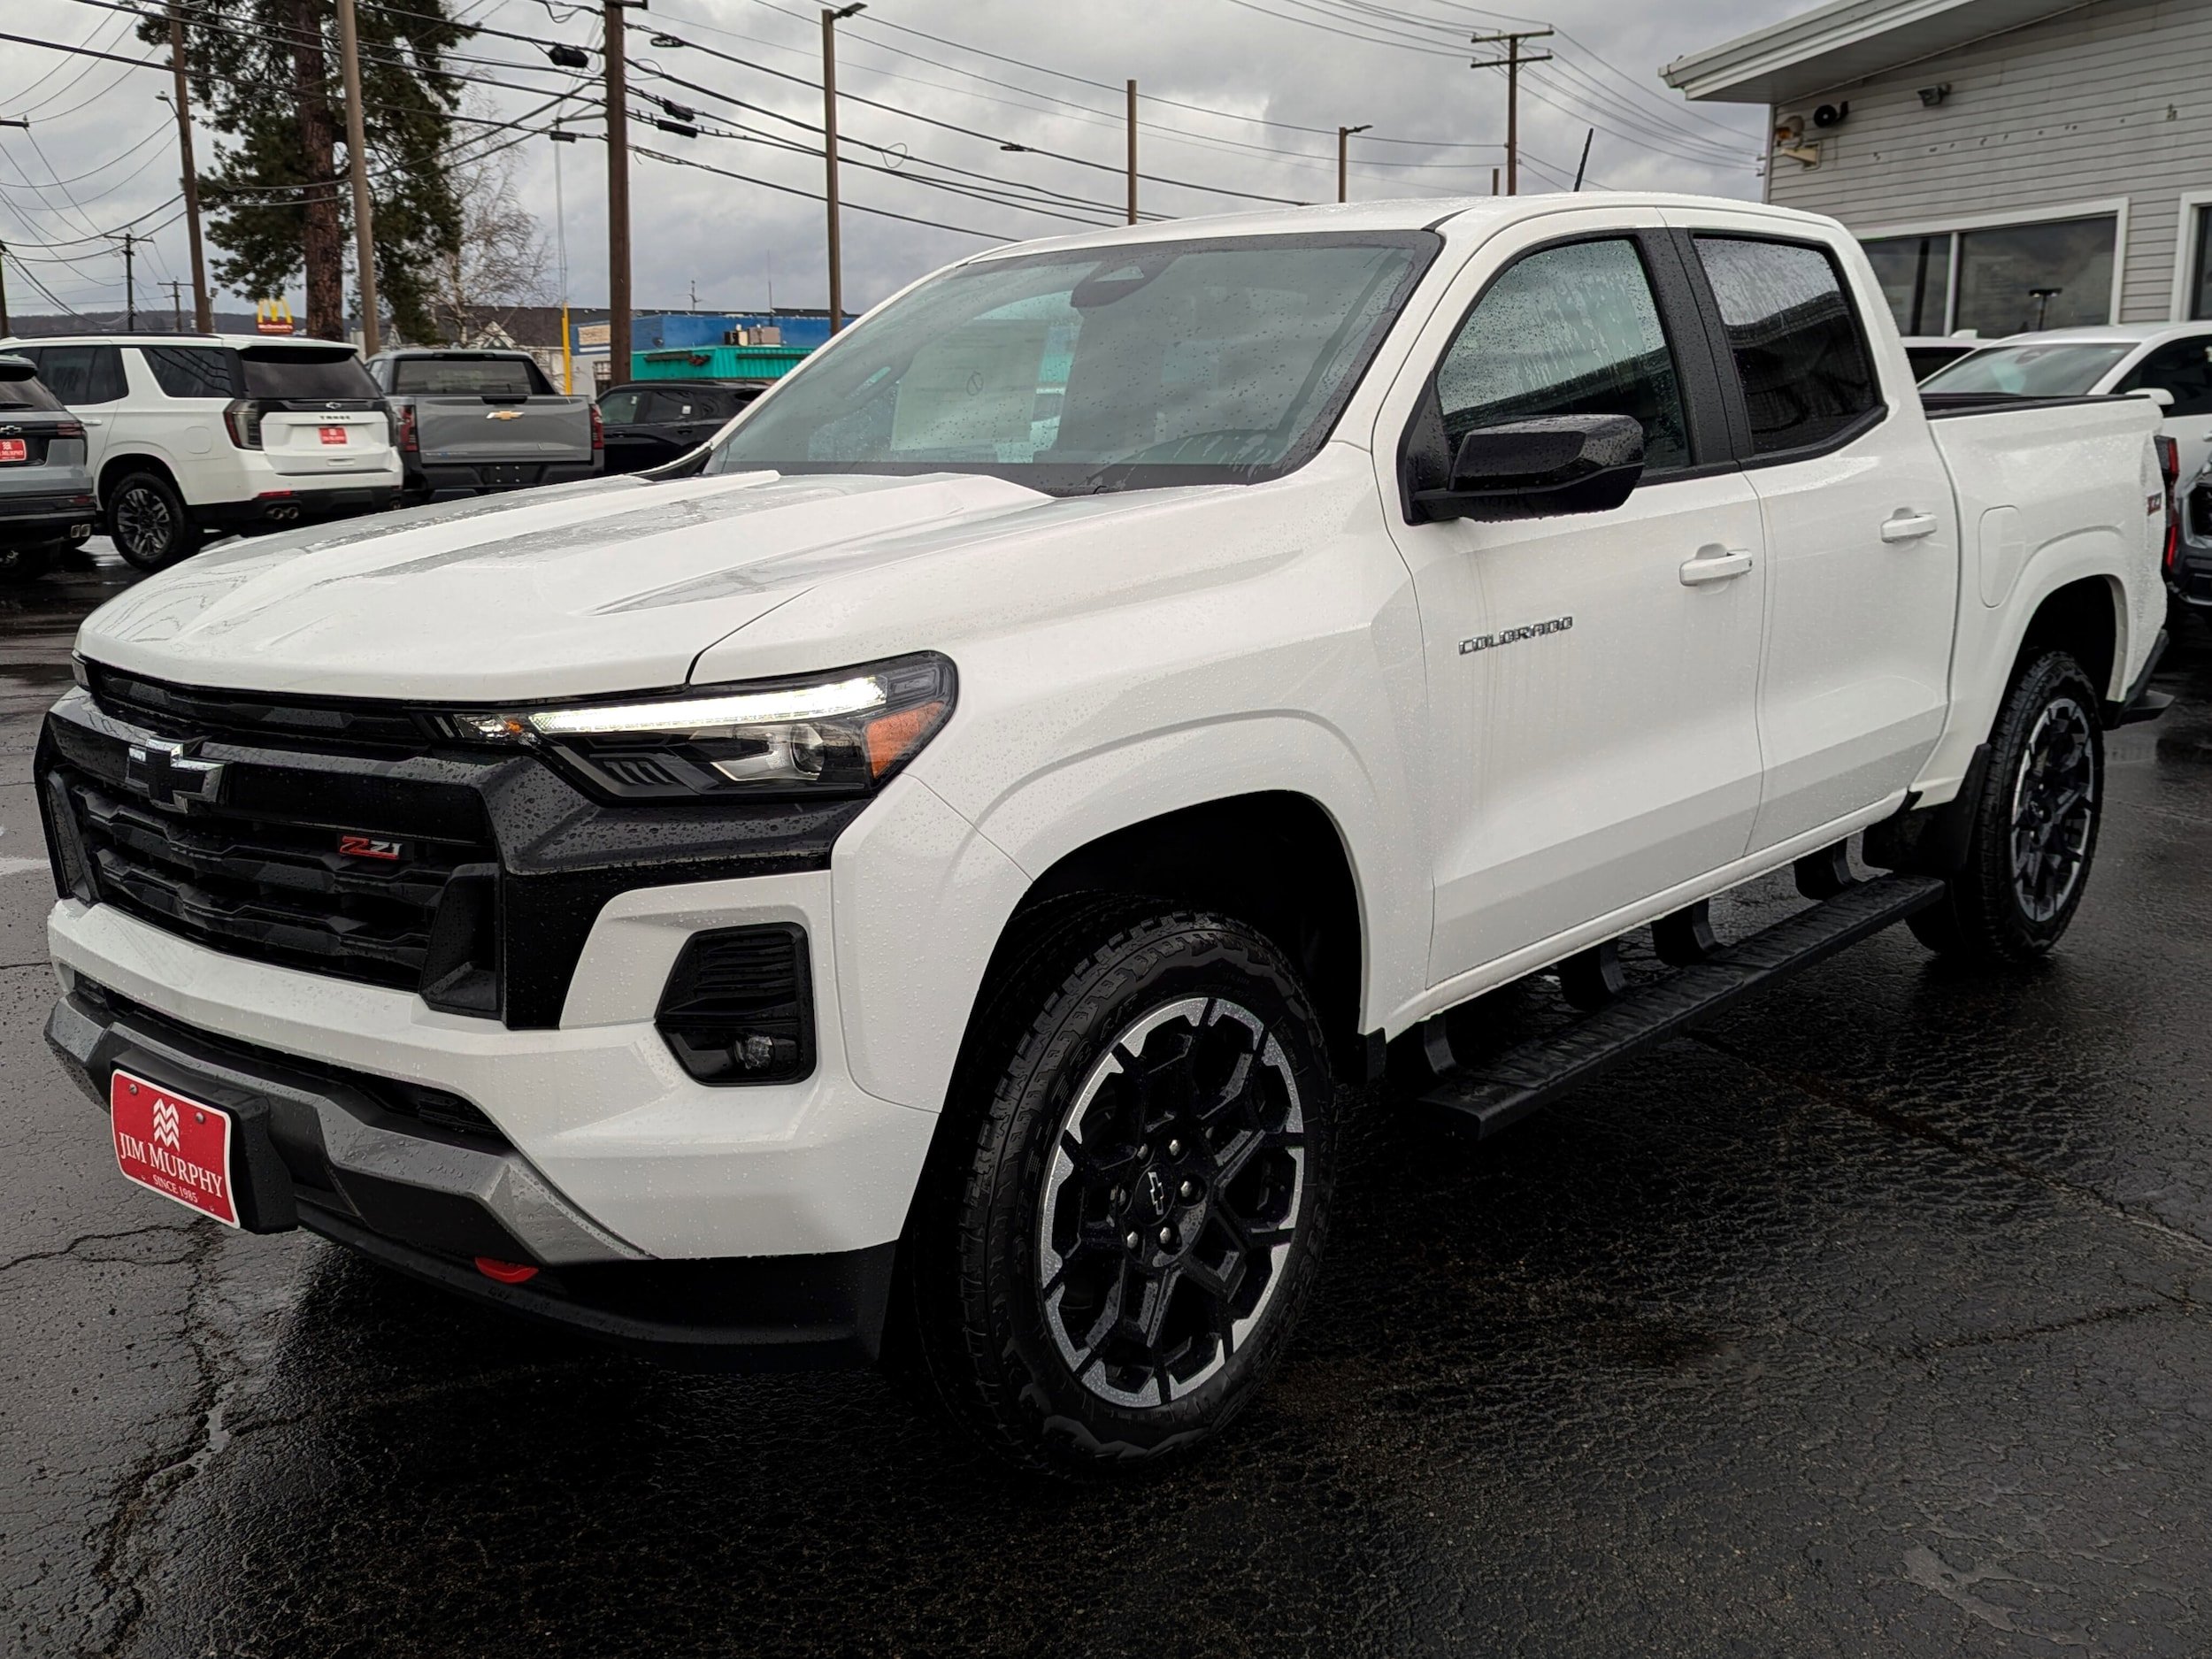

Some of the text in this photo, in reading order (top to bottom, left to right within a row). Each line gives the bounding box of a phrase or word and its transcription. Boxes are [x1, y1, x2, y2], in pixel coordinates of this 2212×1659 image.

[1459, 616, 1572, 656] COLORADO
[340, 835, 403, 860] Z71
[119, 1132, 222, 1198] JIM MURPHY
[152, 1174, 198, 1203] SINCE 1985
